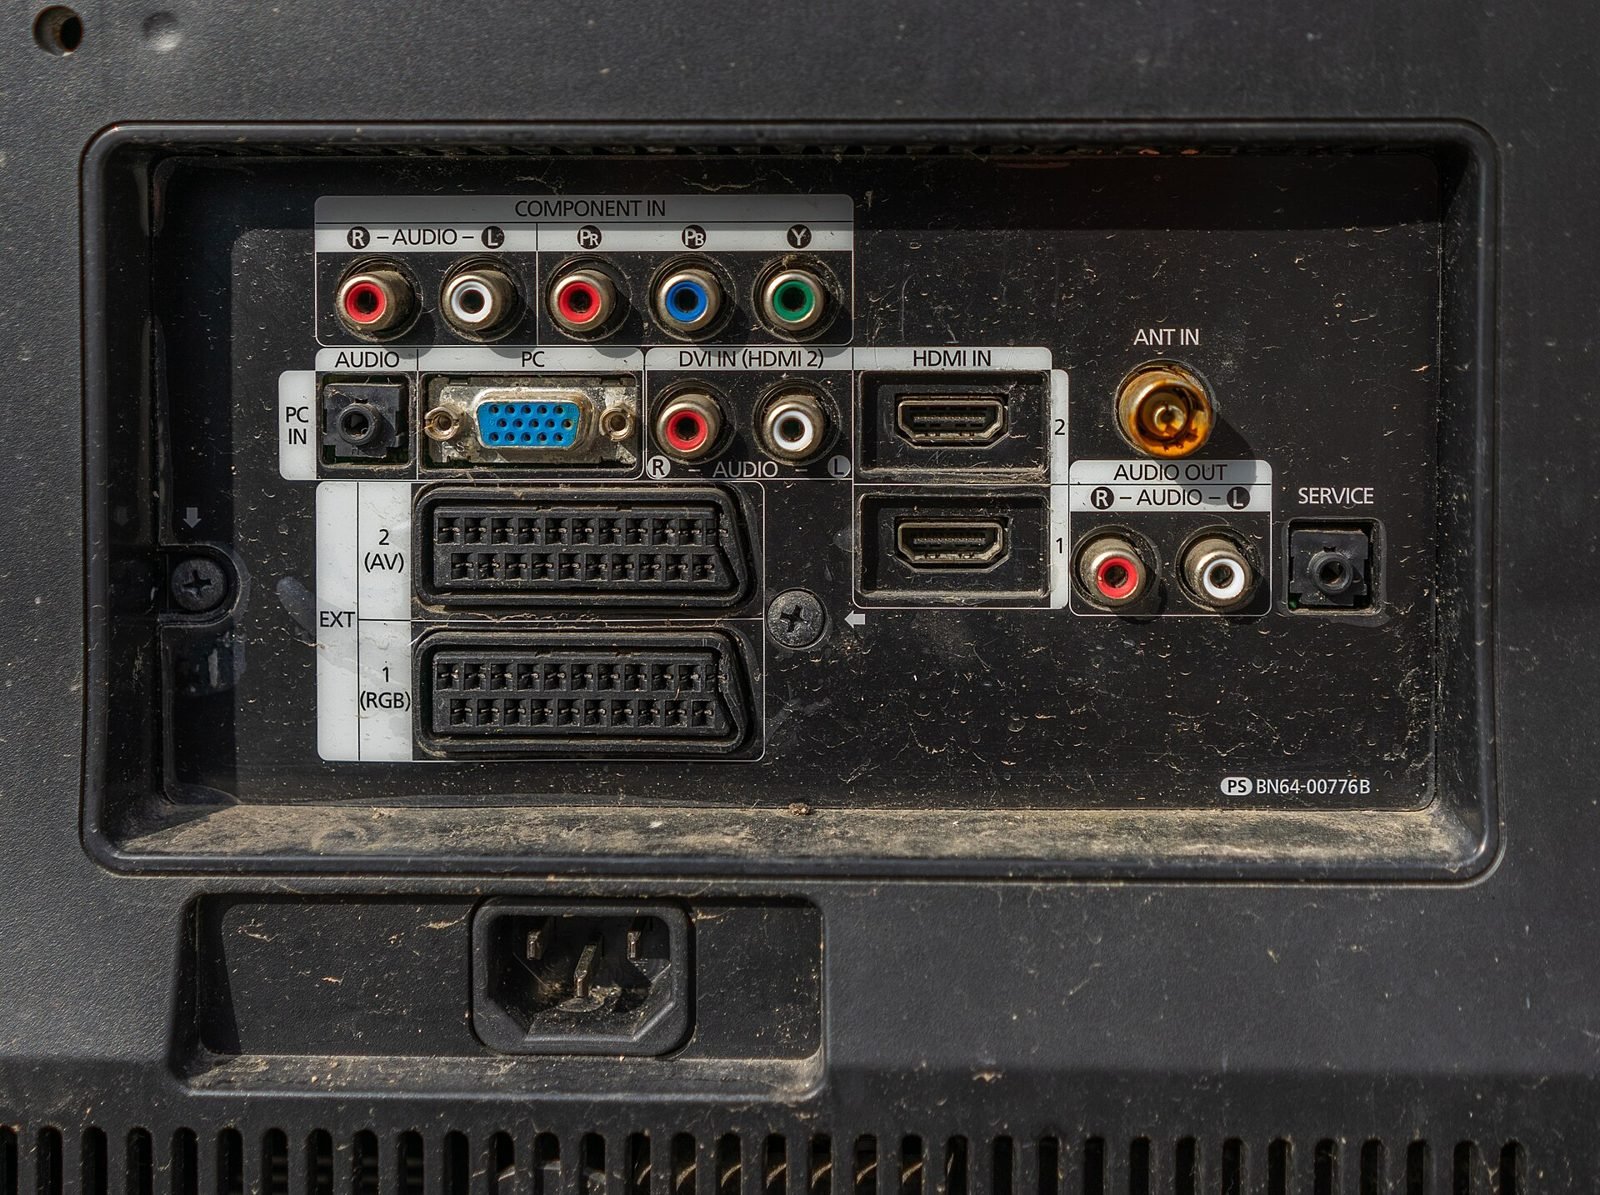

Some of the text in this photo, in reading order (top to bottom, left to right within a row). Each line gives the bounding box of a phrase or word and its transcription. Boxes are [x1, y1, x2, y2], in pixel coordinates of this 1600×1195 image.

[514, 199, 666, 217] COMPONENT IN
[350, 228, 366, 248] R
[391, 228, 458, 246] AUDIO
[790, 227, 807, 246] Y
[1133, 328, 1199, 346] ANT IN
[334, 351, 400, 368] AUDIO
[520, 350, 545, 368] PC
[679, 348, 825, 369] DVI IN (HDMI 2)
[913, 349, 991, 367] HDMI IN
[285, 406, 309, 424] PC
[1054, 418, 1066, 436] 2
[288, 428, 307, 445] IN
[649, 457, 667, 477] R
[712, 460, 778, 478] AUDIO
[1113, 463, 1228, 481] AUDIO OUT
[1094, 486, 1111, 507] R
[1136, 488, 1203, 506] AUDIO
[1298, 487, 1374, 505] SERVICE
[378, 528, 390, 546] 2
[1055, 537, 1064, 554] 1
[363, 552, 404, 574] (AV)
[319, 610, 356, 628] EXT
[382, 666, 390, 683] 1
[359, 691, 411, 711] (RGB)
[1226, 778, 1371, 795] PS BN64-00776B
